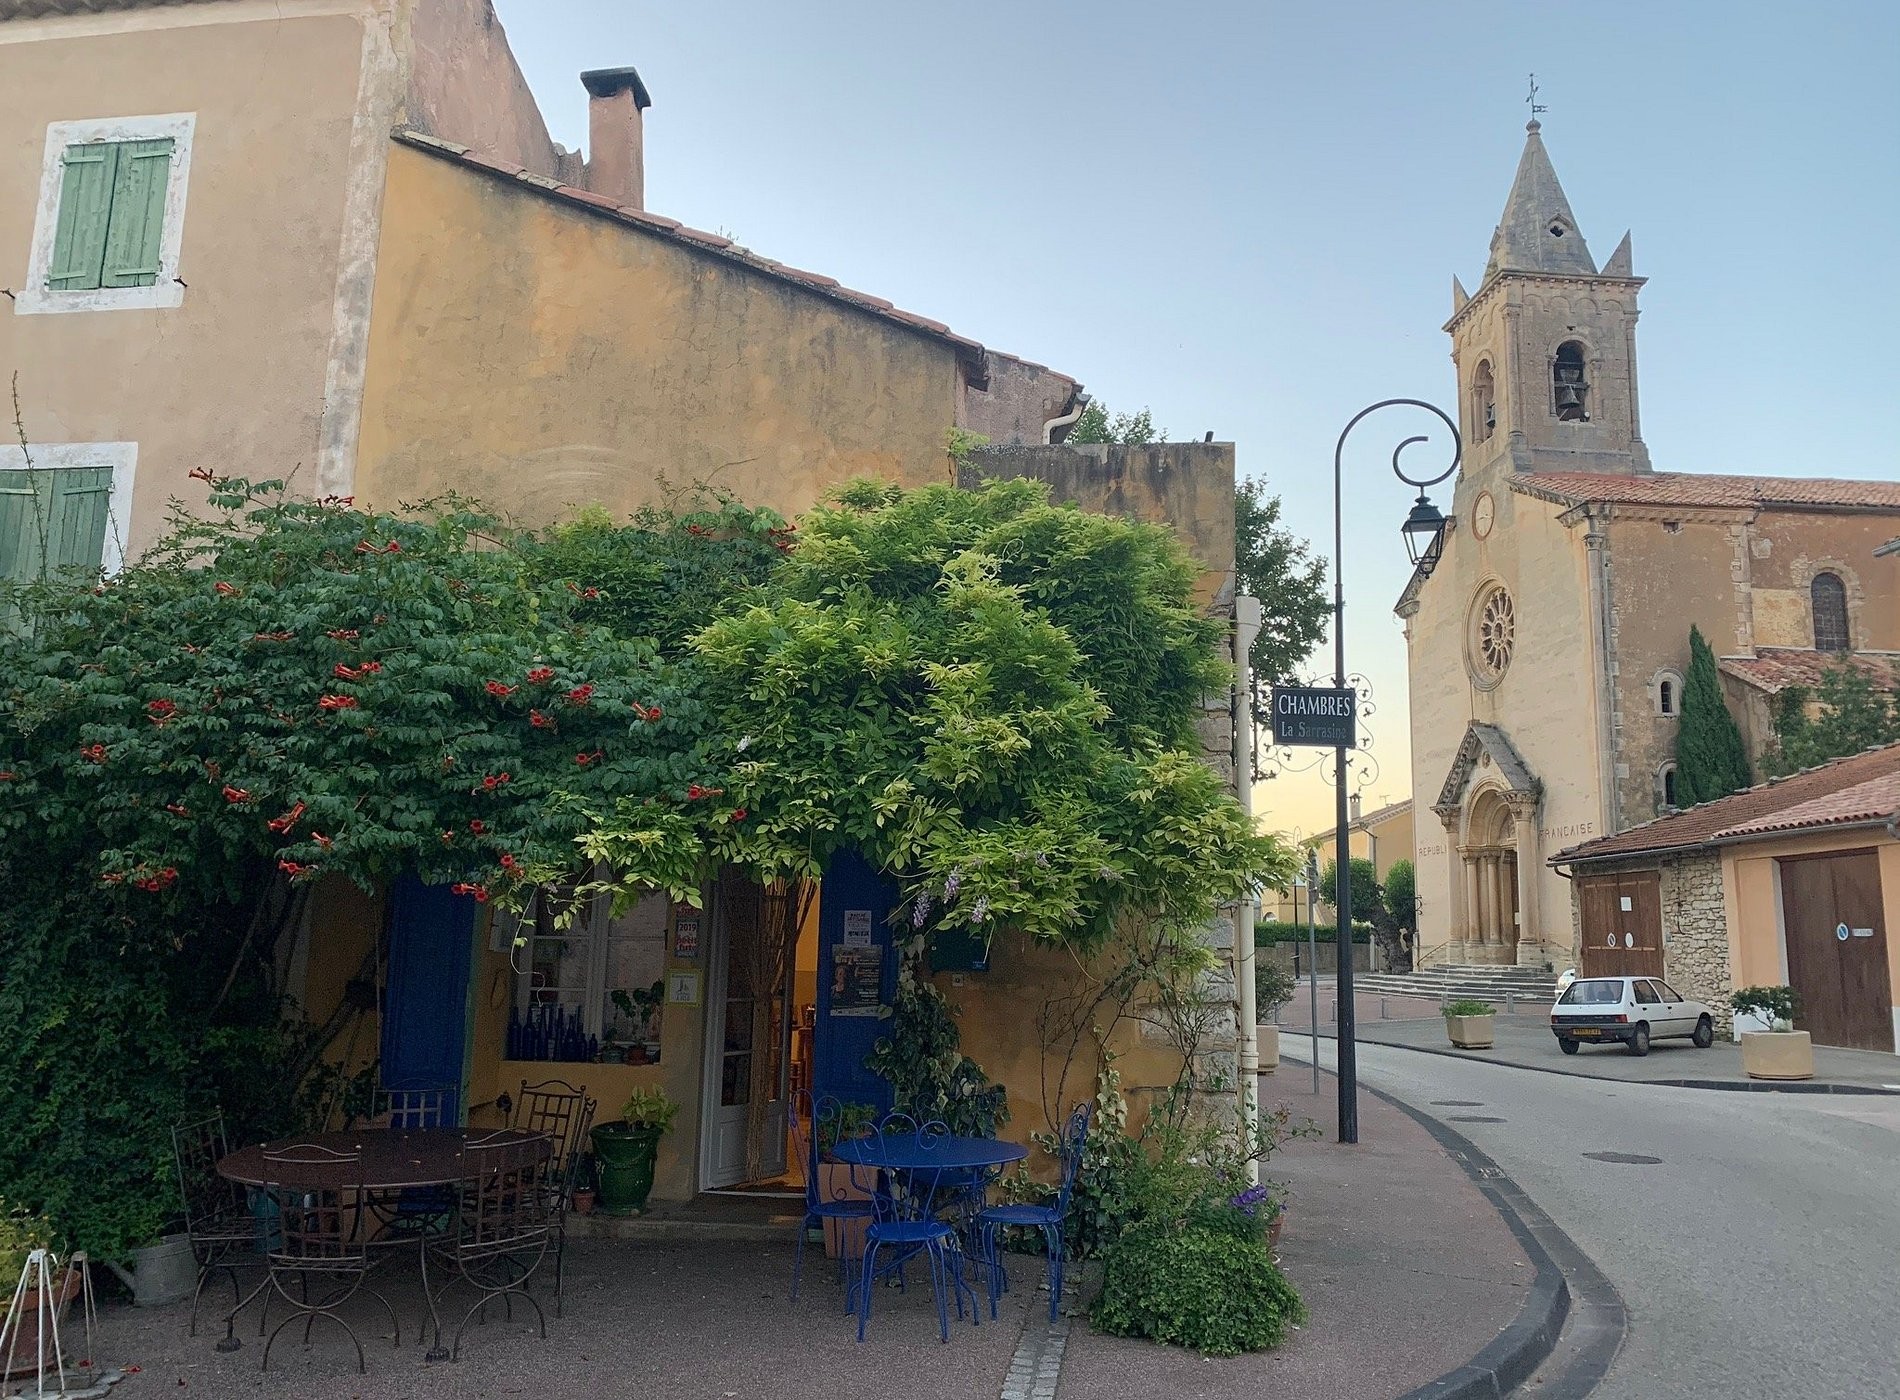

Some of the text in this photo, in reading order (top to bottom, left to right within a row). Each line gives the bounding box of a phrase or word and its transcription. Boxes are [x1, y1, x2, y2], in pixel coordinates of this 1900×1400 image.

[1278, 694, 1351, 717] CHAMBRES
[1281, 721, 1347, 739] La Sarrasine
[679, 923, 697, 932] 2019
